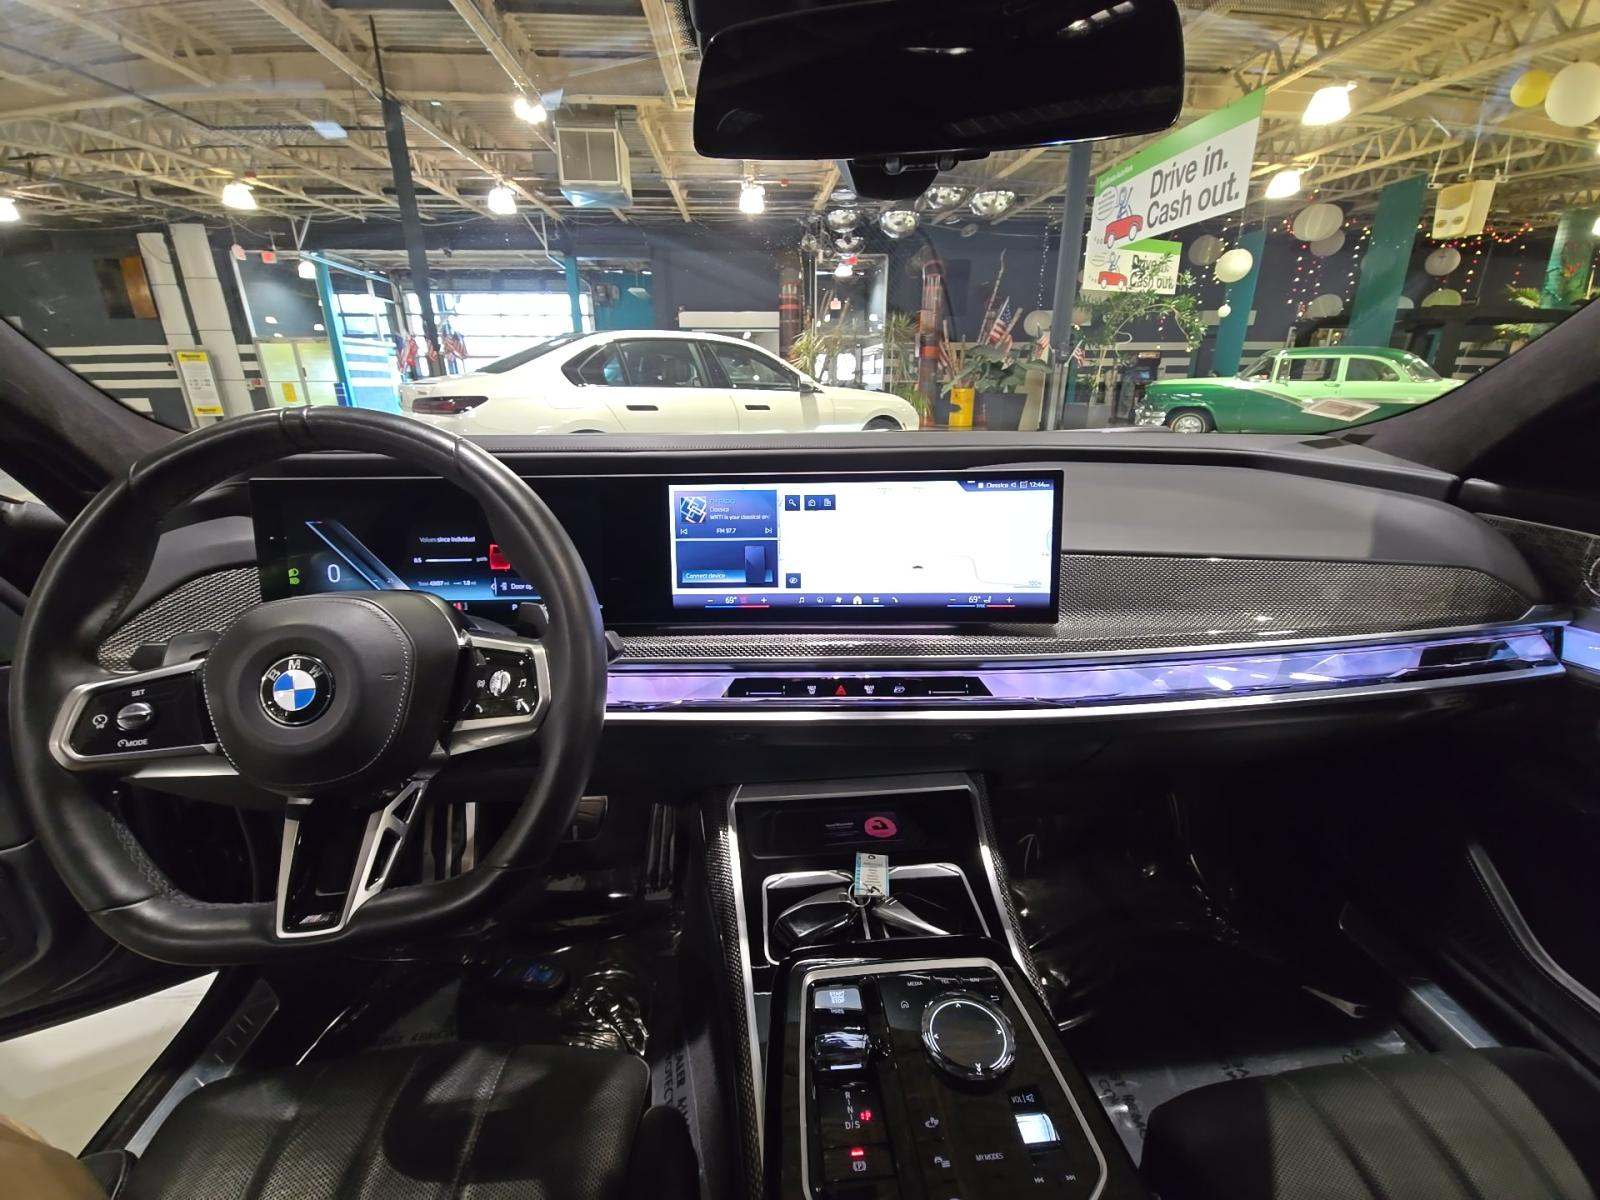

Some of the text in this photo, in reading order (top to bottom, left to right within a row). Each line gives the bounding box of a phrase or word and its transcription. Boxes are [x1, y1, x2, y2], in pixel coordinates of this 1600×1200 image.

[1151, 160, 1197, 198] Drive
[1203, 145, 1228, 177] in.
[1147, 189, 1192, 228] Cash
[1198, 172, 1240, 211] out.
[1130, 271, 1154, 288] Cash
[327, 564, 341, 584] 0
[266, 659, 323, 682] BMW
[131, 688, 145, 697] SET
[127, 738, 148, 747] MODE
